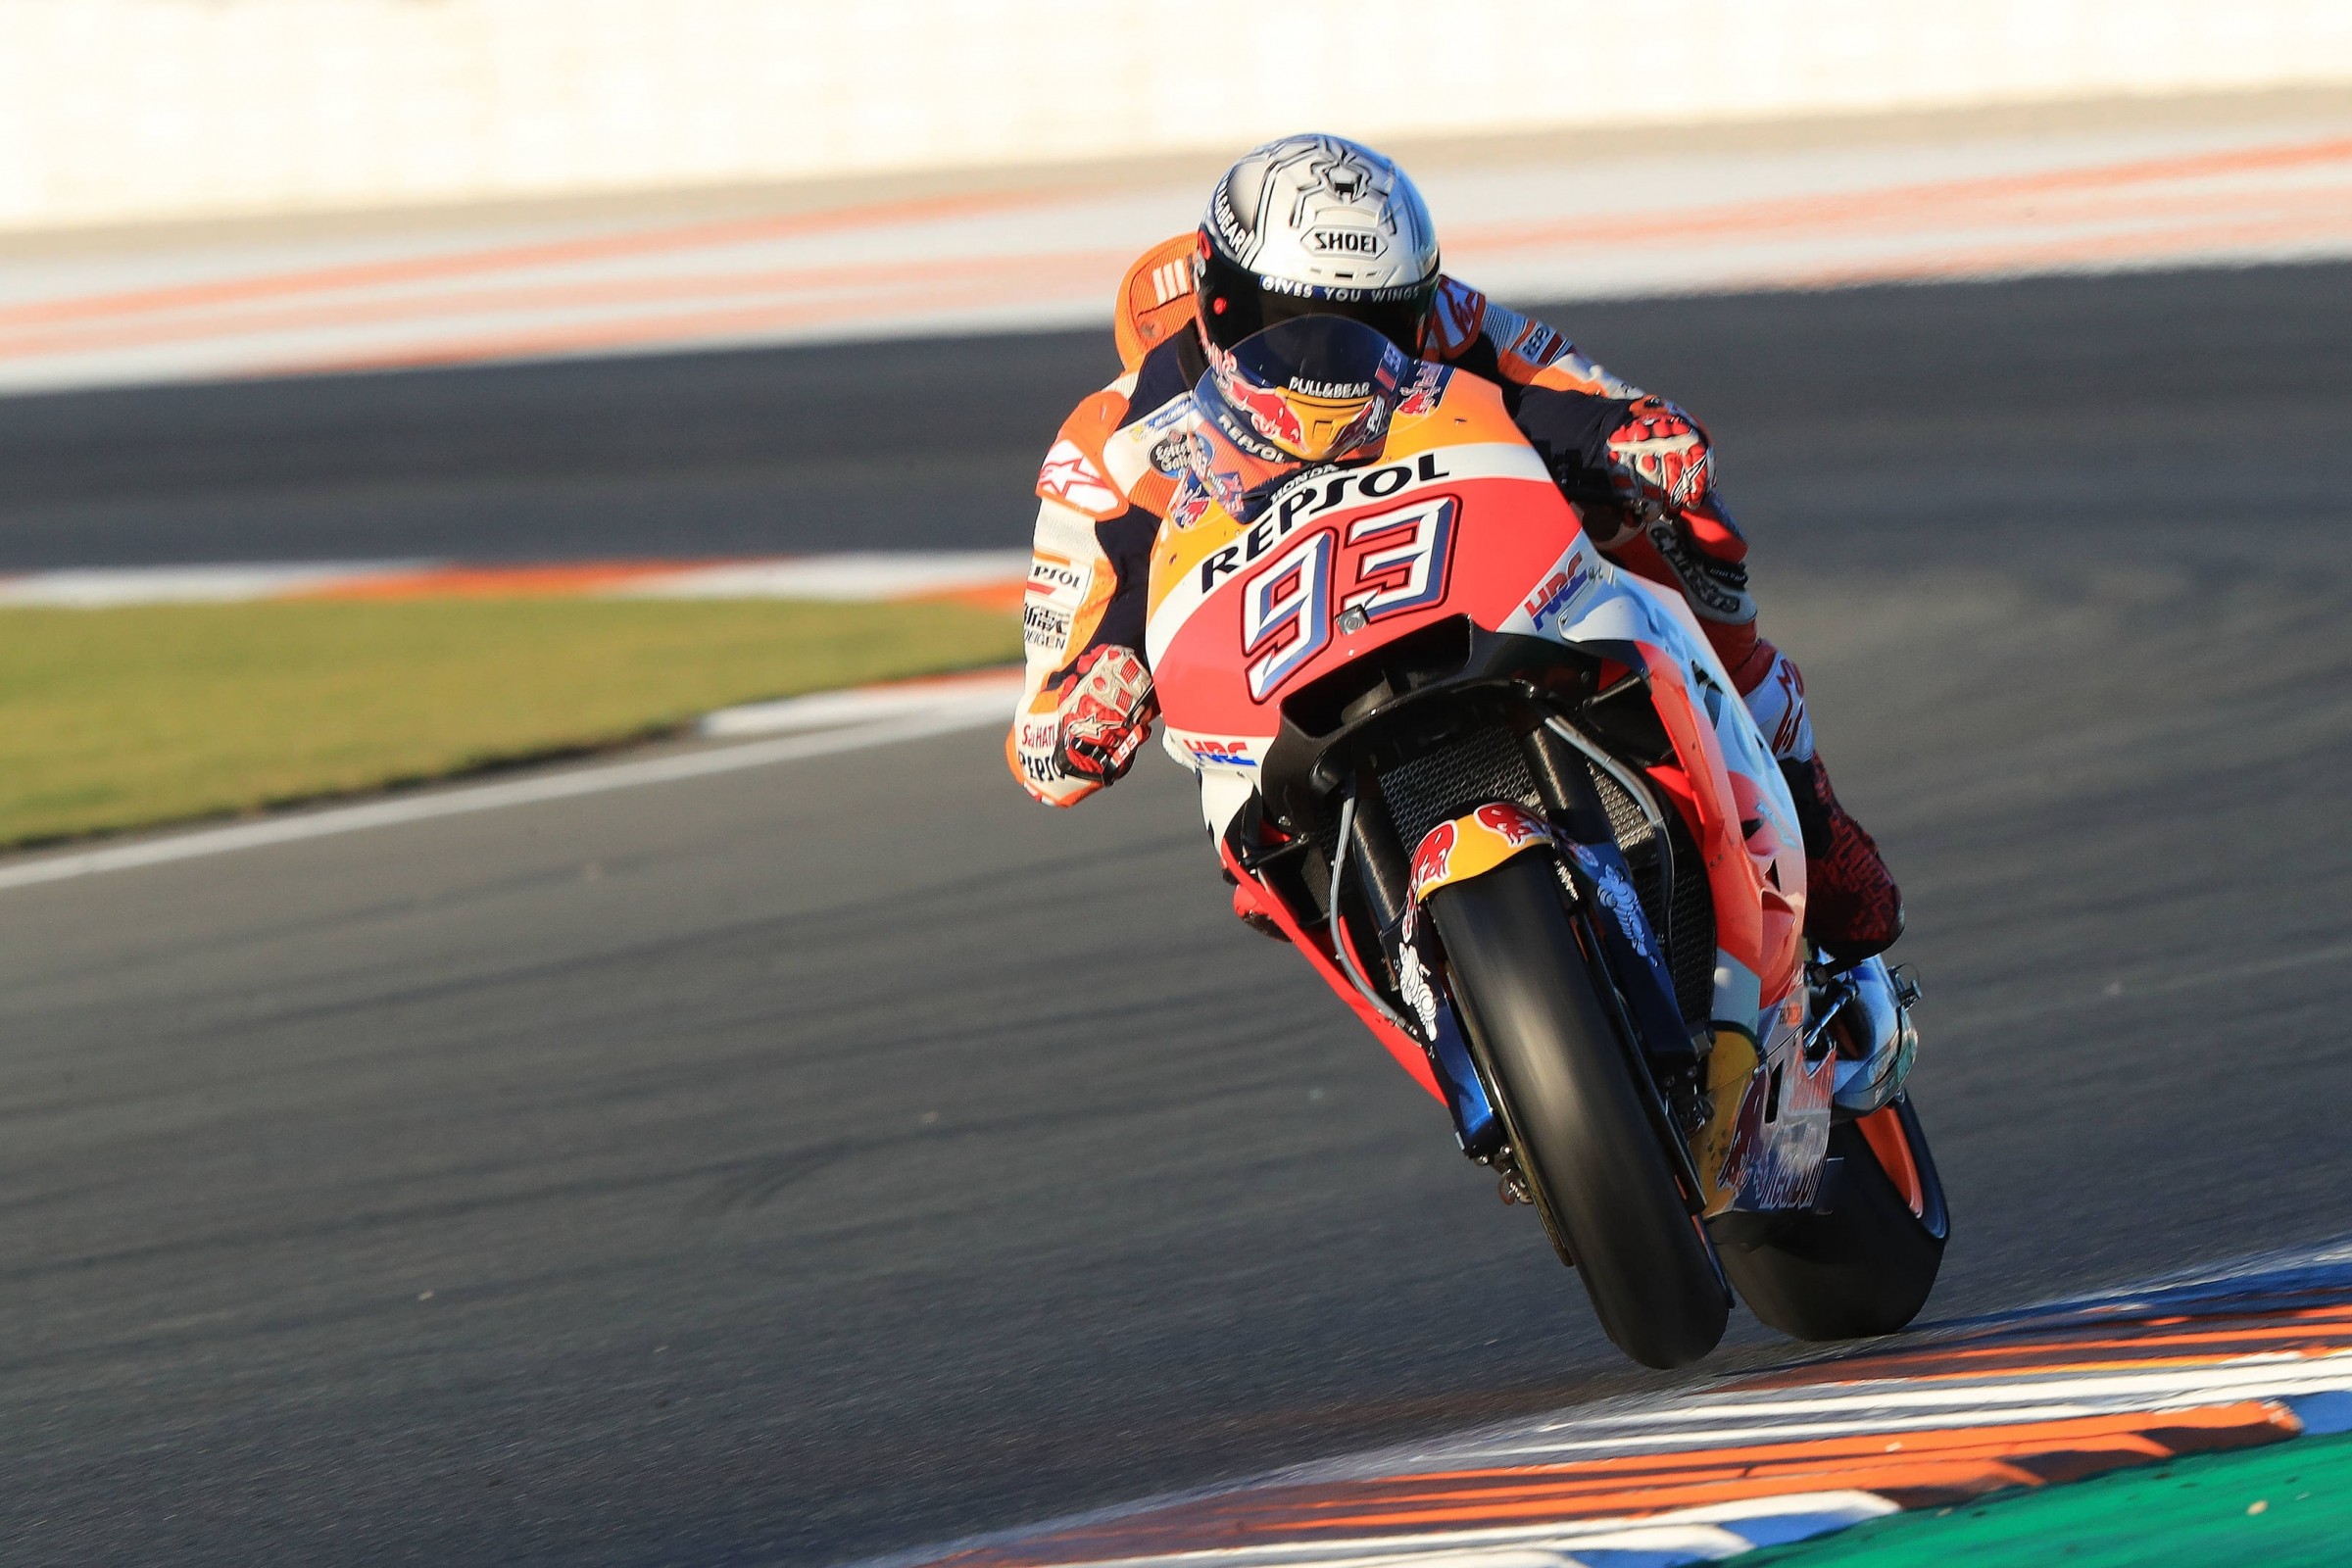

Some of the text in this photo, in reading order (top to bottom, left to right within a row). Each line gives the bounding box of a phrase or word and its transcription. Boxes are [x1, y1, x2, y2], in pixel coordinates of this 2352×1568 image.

[1313, 232, 1377, 255] SHOEI
[1261, 275, 1420, 304] GIVES YOU WINGS
[1289, 375, 1371, 399] PULL&BEAR
[1201, 453, 1450, 595] REPSOL
[1242, 495, 1462, 705] 93
[1117, 730, 1139, 762] 93
[1183, 740, 1257, 766] HRC
